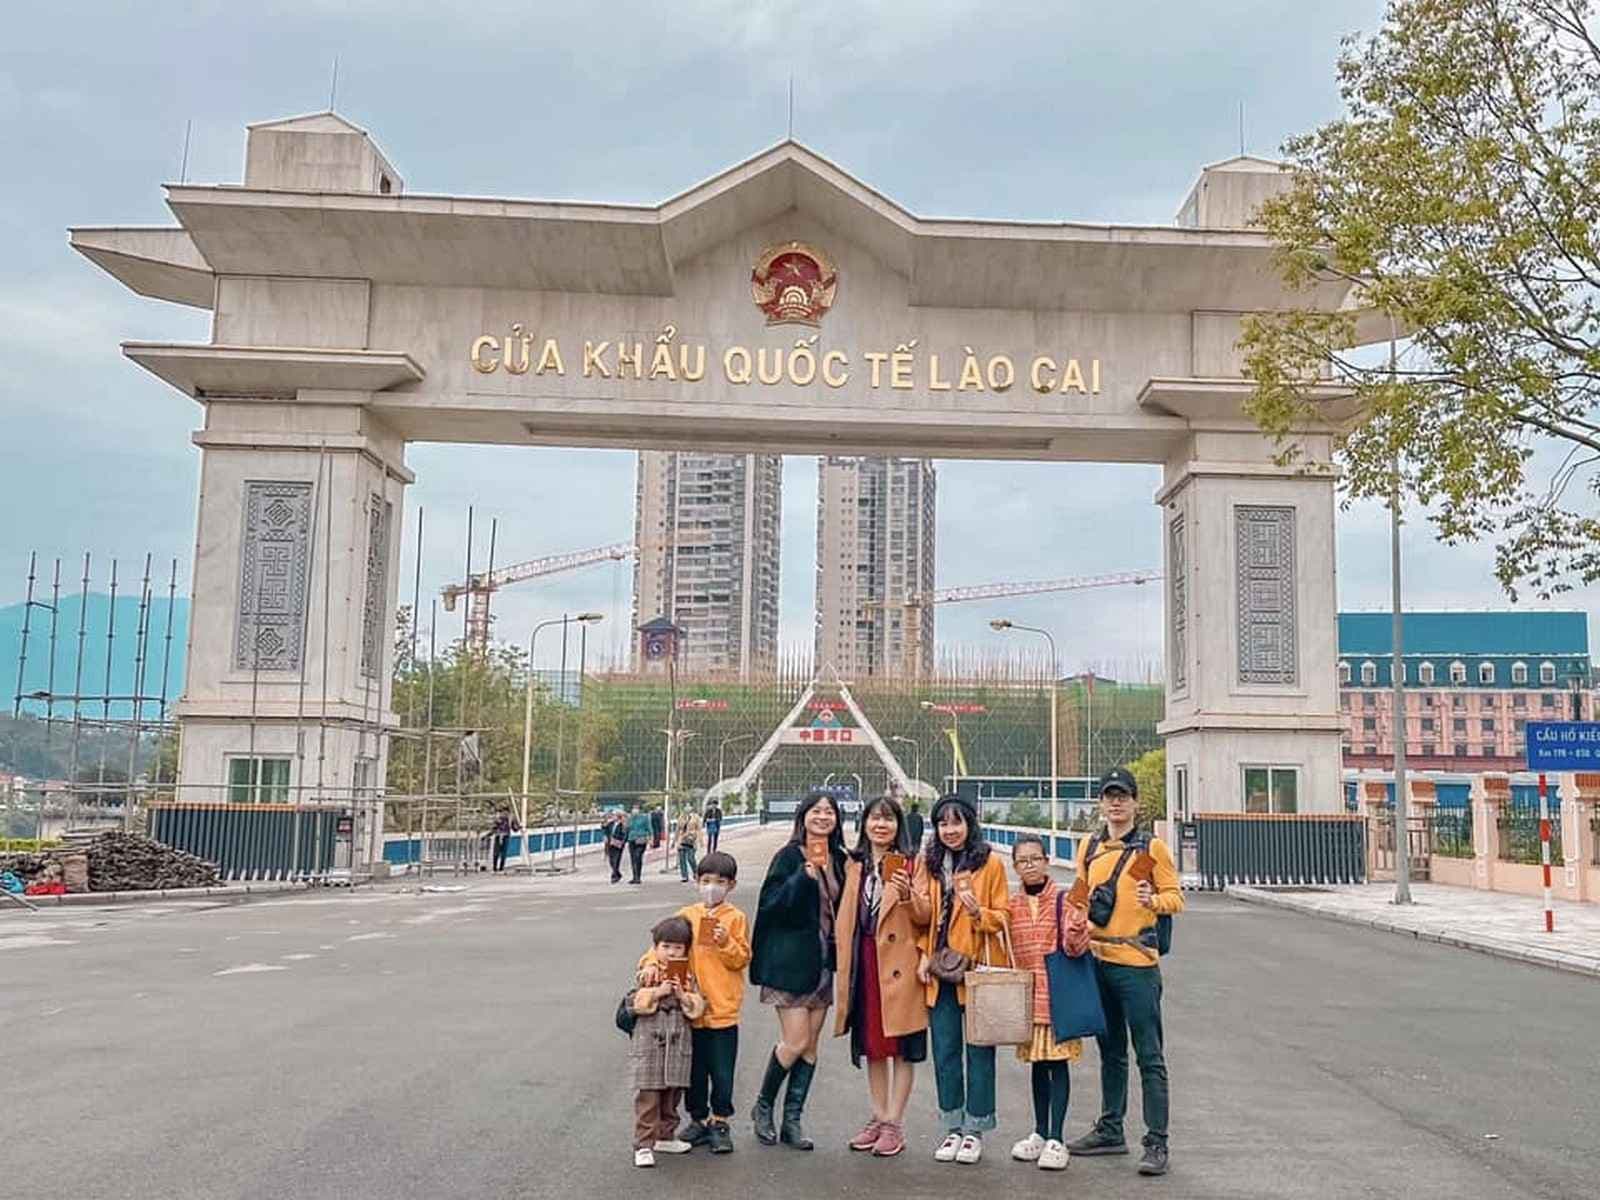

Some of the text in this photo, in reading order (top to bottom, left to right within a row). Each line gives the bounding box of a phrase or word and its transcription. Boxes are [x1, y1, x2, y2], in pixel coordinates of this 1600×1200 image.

[471, 323, 1101, 395] CỬA KHẨU QUỐC TẾ LÀO CAI
